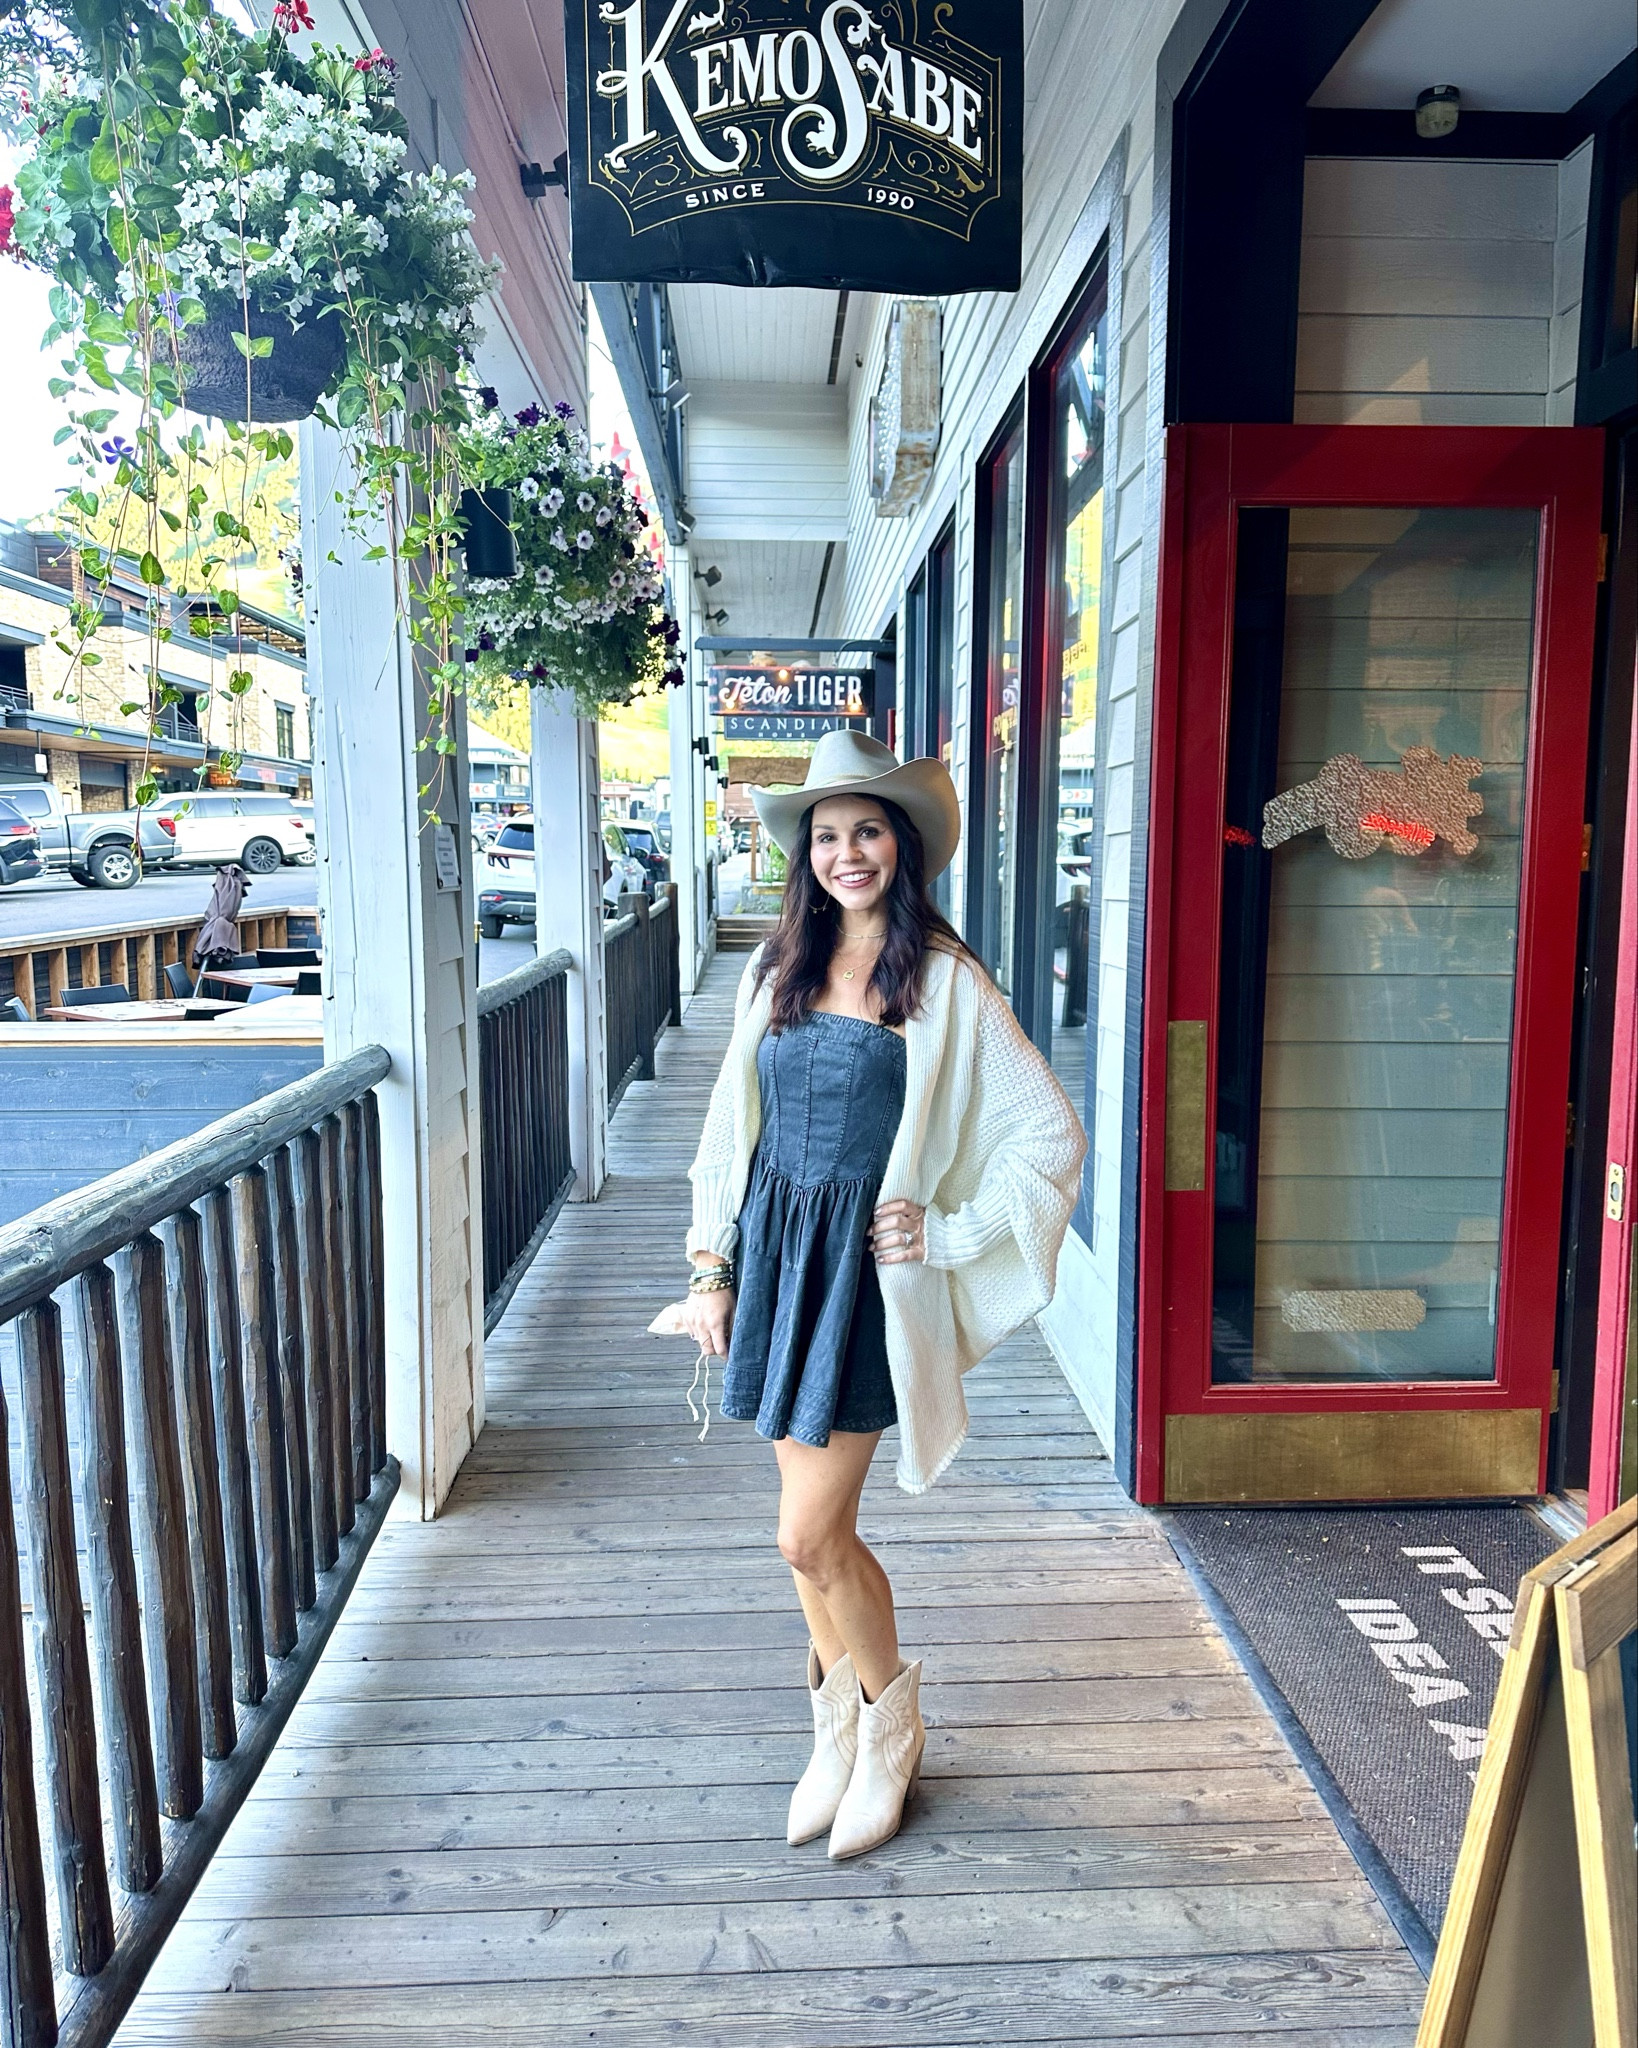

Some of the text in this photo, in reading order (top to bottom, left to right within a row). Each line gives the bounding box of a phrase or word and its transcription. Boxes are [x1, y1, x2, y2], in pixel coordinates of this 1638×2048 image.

[685, 182, 915, 210] SINCE 1990
[718, 675, 865, 706] Teton TIGER
[730, 717, 832, 731] SCANDIA
[1335, 1598, 1472, 1708] IDEA
